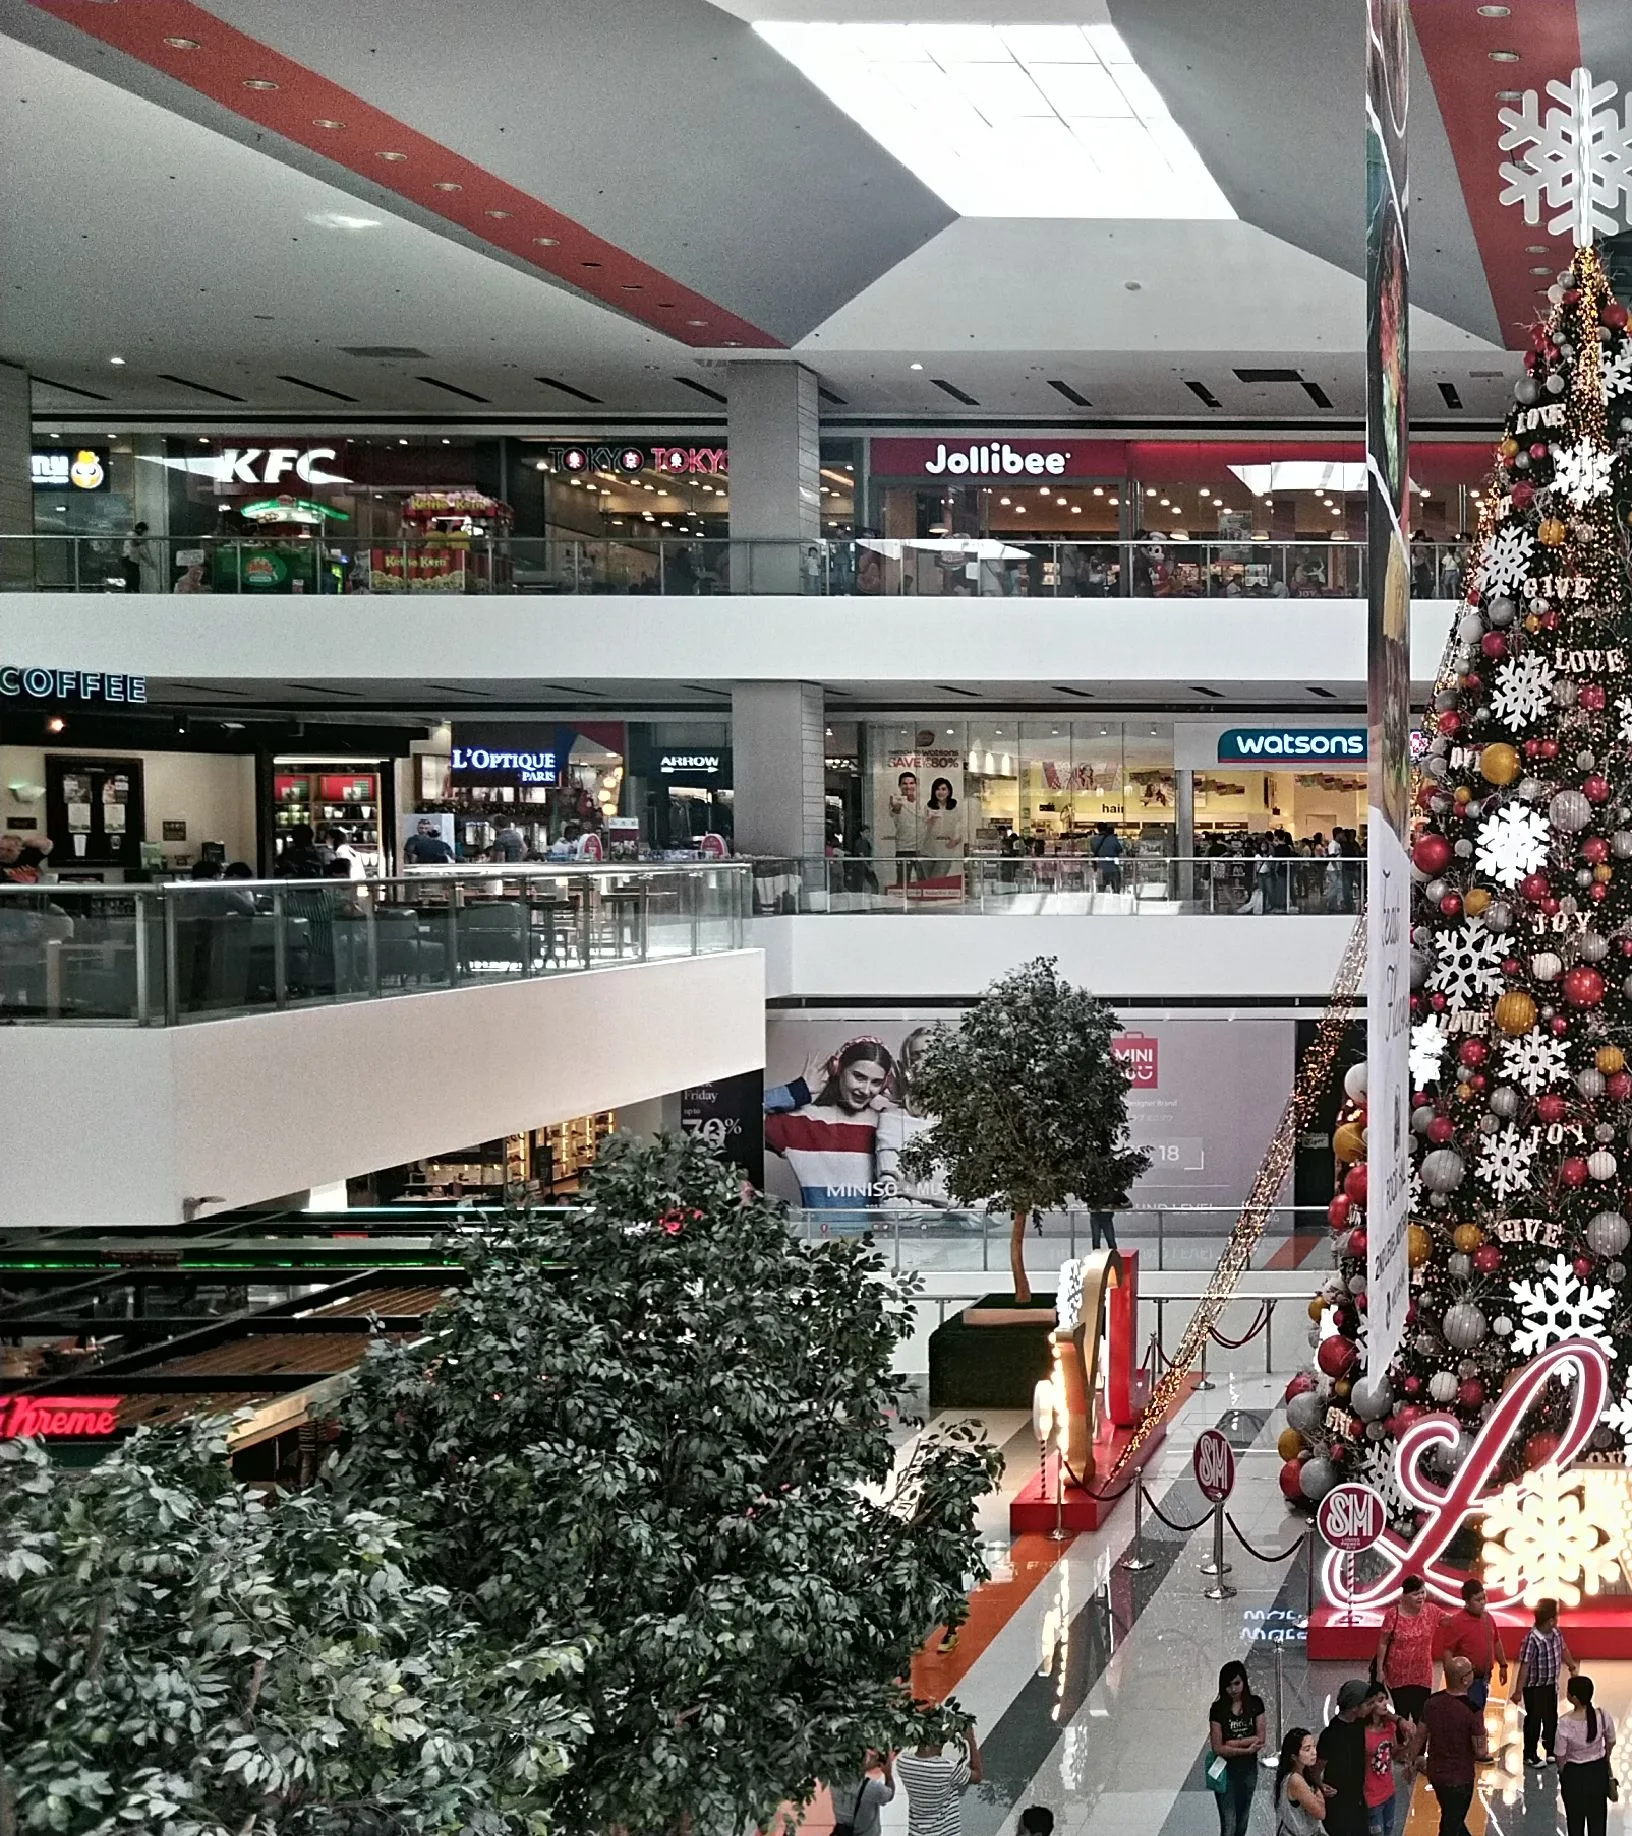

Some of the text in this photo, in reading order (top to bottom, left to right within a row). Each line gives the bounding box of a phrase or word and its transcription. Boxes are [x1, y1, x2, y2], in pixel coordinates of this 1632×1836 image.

[221, 449, 340, 484] KFC
[549, 448, 645, 473] TOKYO
[925, 443, 1065, 476] Jollibee
[1523, 574, 1591, 600] GIVE
[1554, 648, 1628, 673] LOVE
[0, 667, 147, 703] COFFEE
[1236, 733, 1365, 754] watsons
[453, 749, 556, 769] L'OPTIQUE
[661, 756, 719, 767] ARROW
[888, 757, 921, 768] SAVE
[522, 771, 556, 782] PARIS
[1532, 911, 1592, 935] JOY
[684, 1090, 718, 1103] Friday
[1160, 1145, 1180, 1162] 18
[826, 1181, 898, 1198] MINISO
[6, 1396, 125, 1438] Kreme
[1200, 1435, 1228, 1490] SM
[1326, 1492, 1374, 1537] SM
